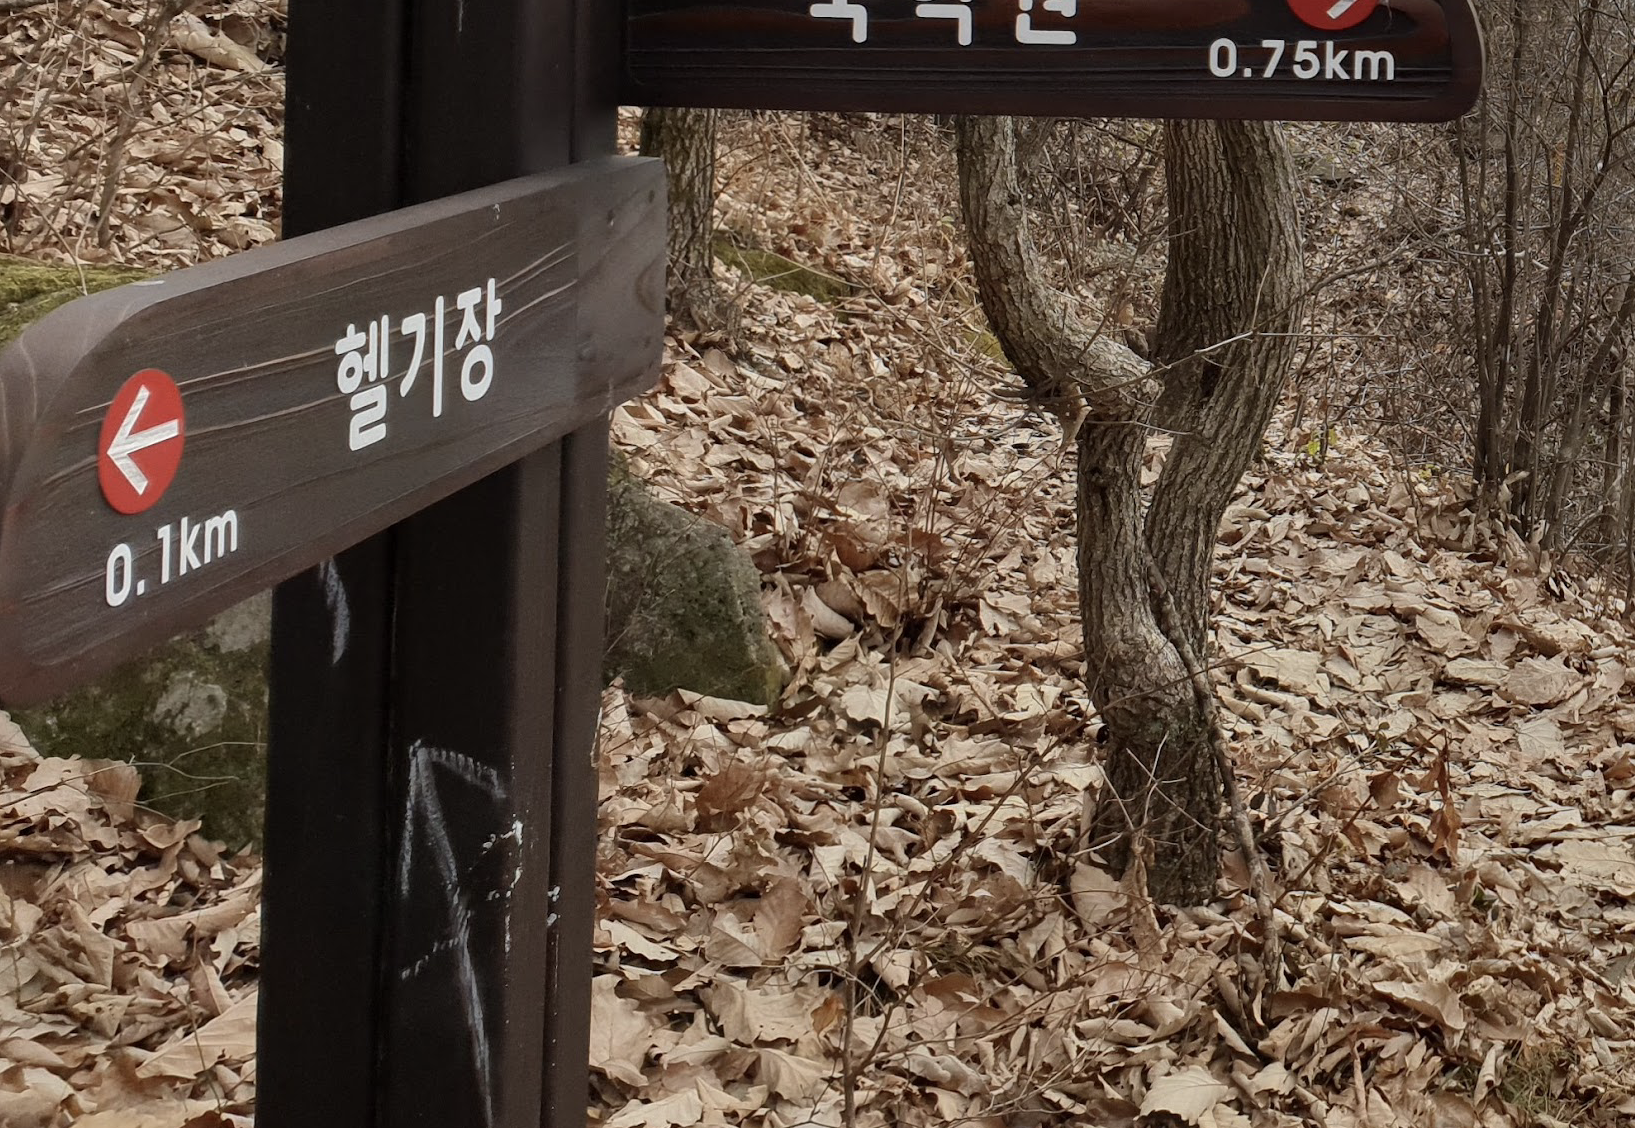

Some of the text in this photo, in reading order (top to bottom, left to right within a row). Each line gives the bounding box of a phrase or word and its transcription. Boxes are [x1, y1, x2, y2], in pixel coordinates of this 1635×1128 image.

[1209, 37, 1395, 80] 0.75km
[335, 278, 502, 451] 헬기장
[106, 509, 238, 607] 0.1km
